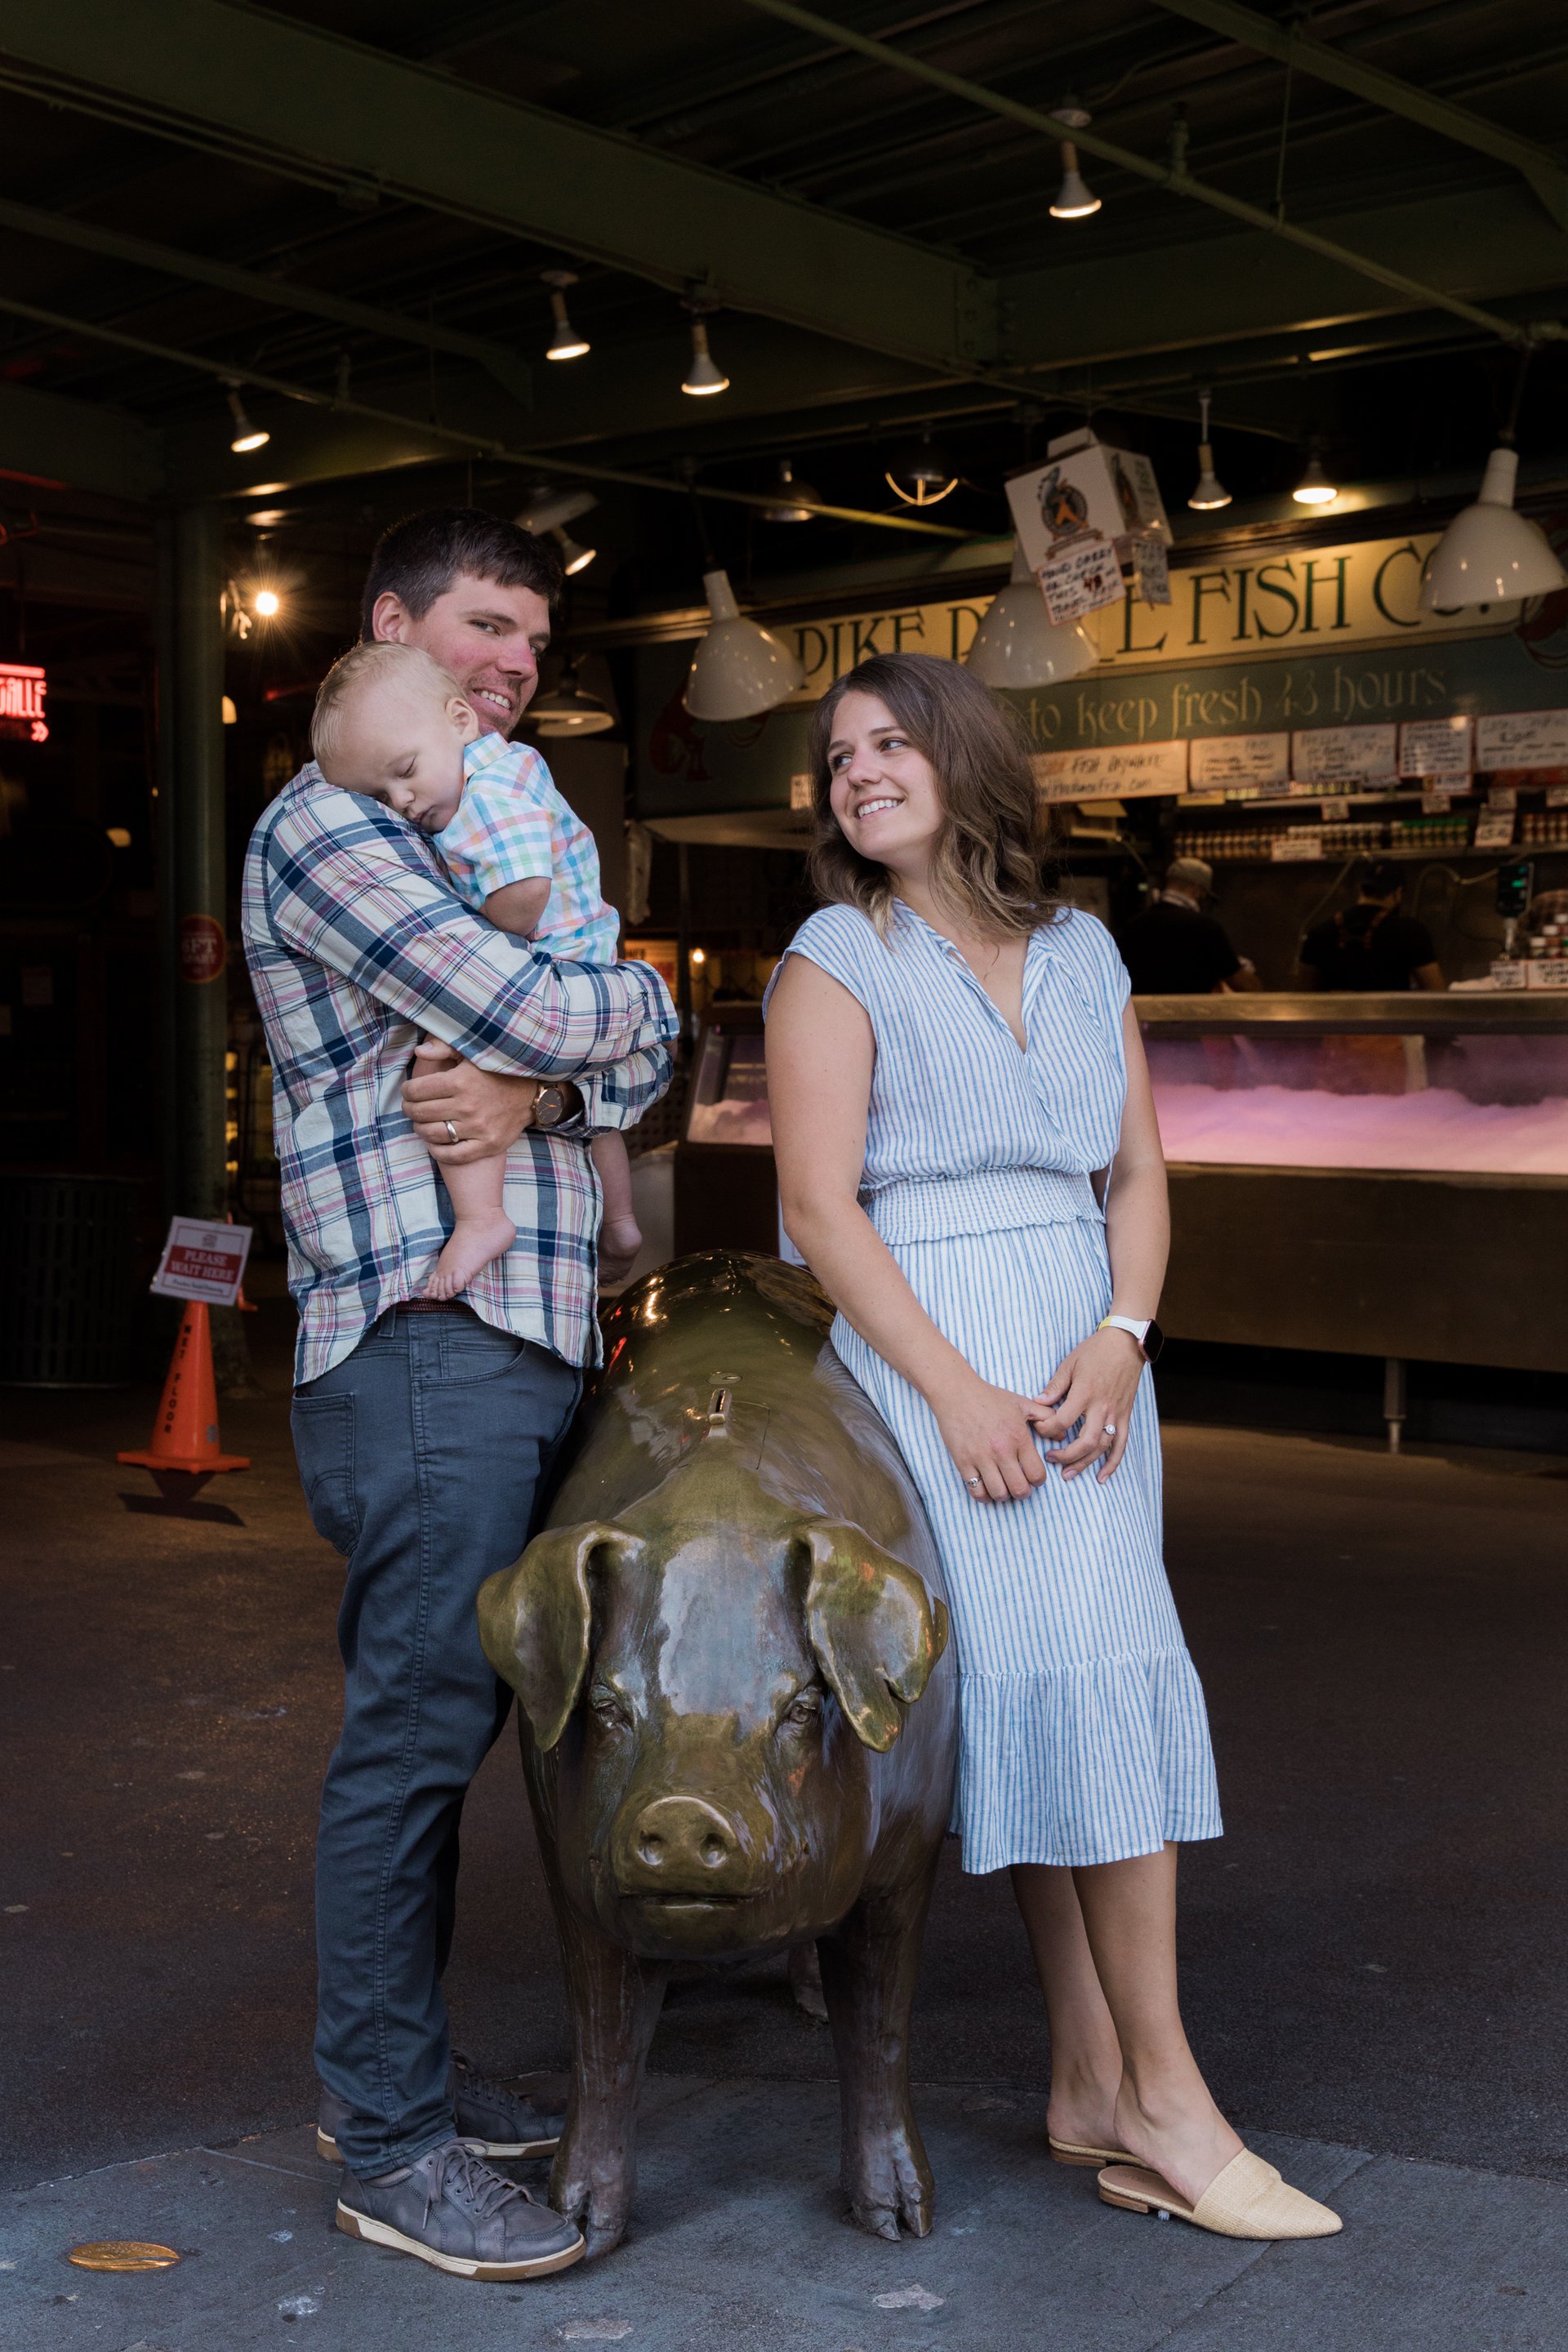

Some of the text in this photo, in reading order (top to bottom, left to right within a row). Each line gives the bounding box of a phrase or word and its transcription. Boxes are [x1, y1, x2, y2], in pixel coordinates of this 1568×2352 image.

[793, 609, 924, 689] PIKE
[1187, 556, 1354, 645] FISH
[1077, 692, 1158, 743] keep
[1171, 676, 1263, 740] fresh
[1332, 666, 1448, 722] hours
[171, 1260, 235, 1282] WAIT HERE
[184, 1250, 228, 1267] PLEASE
